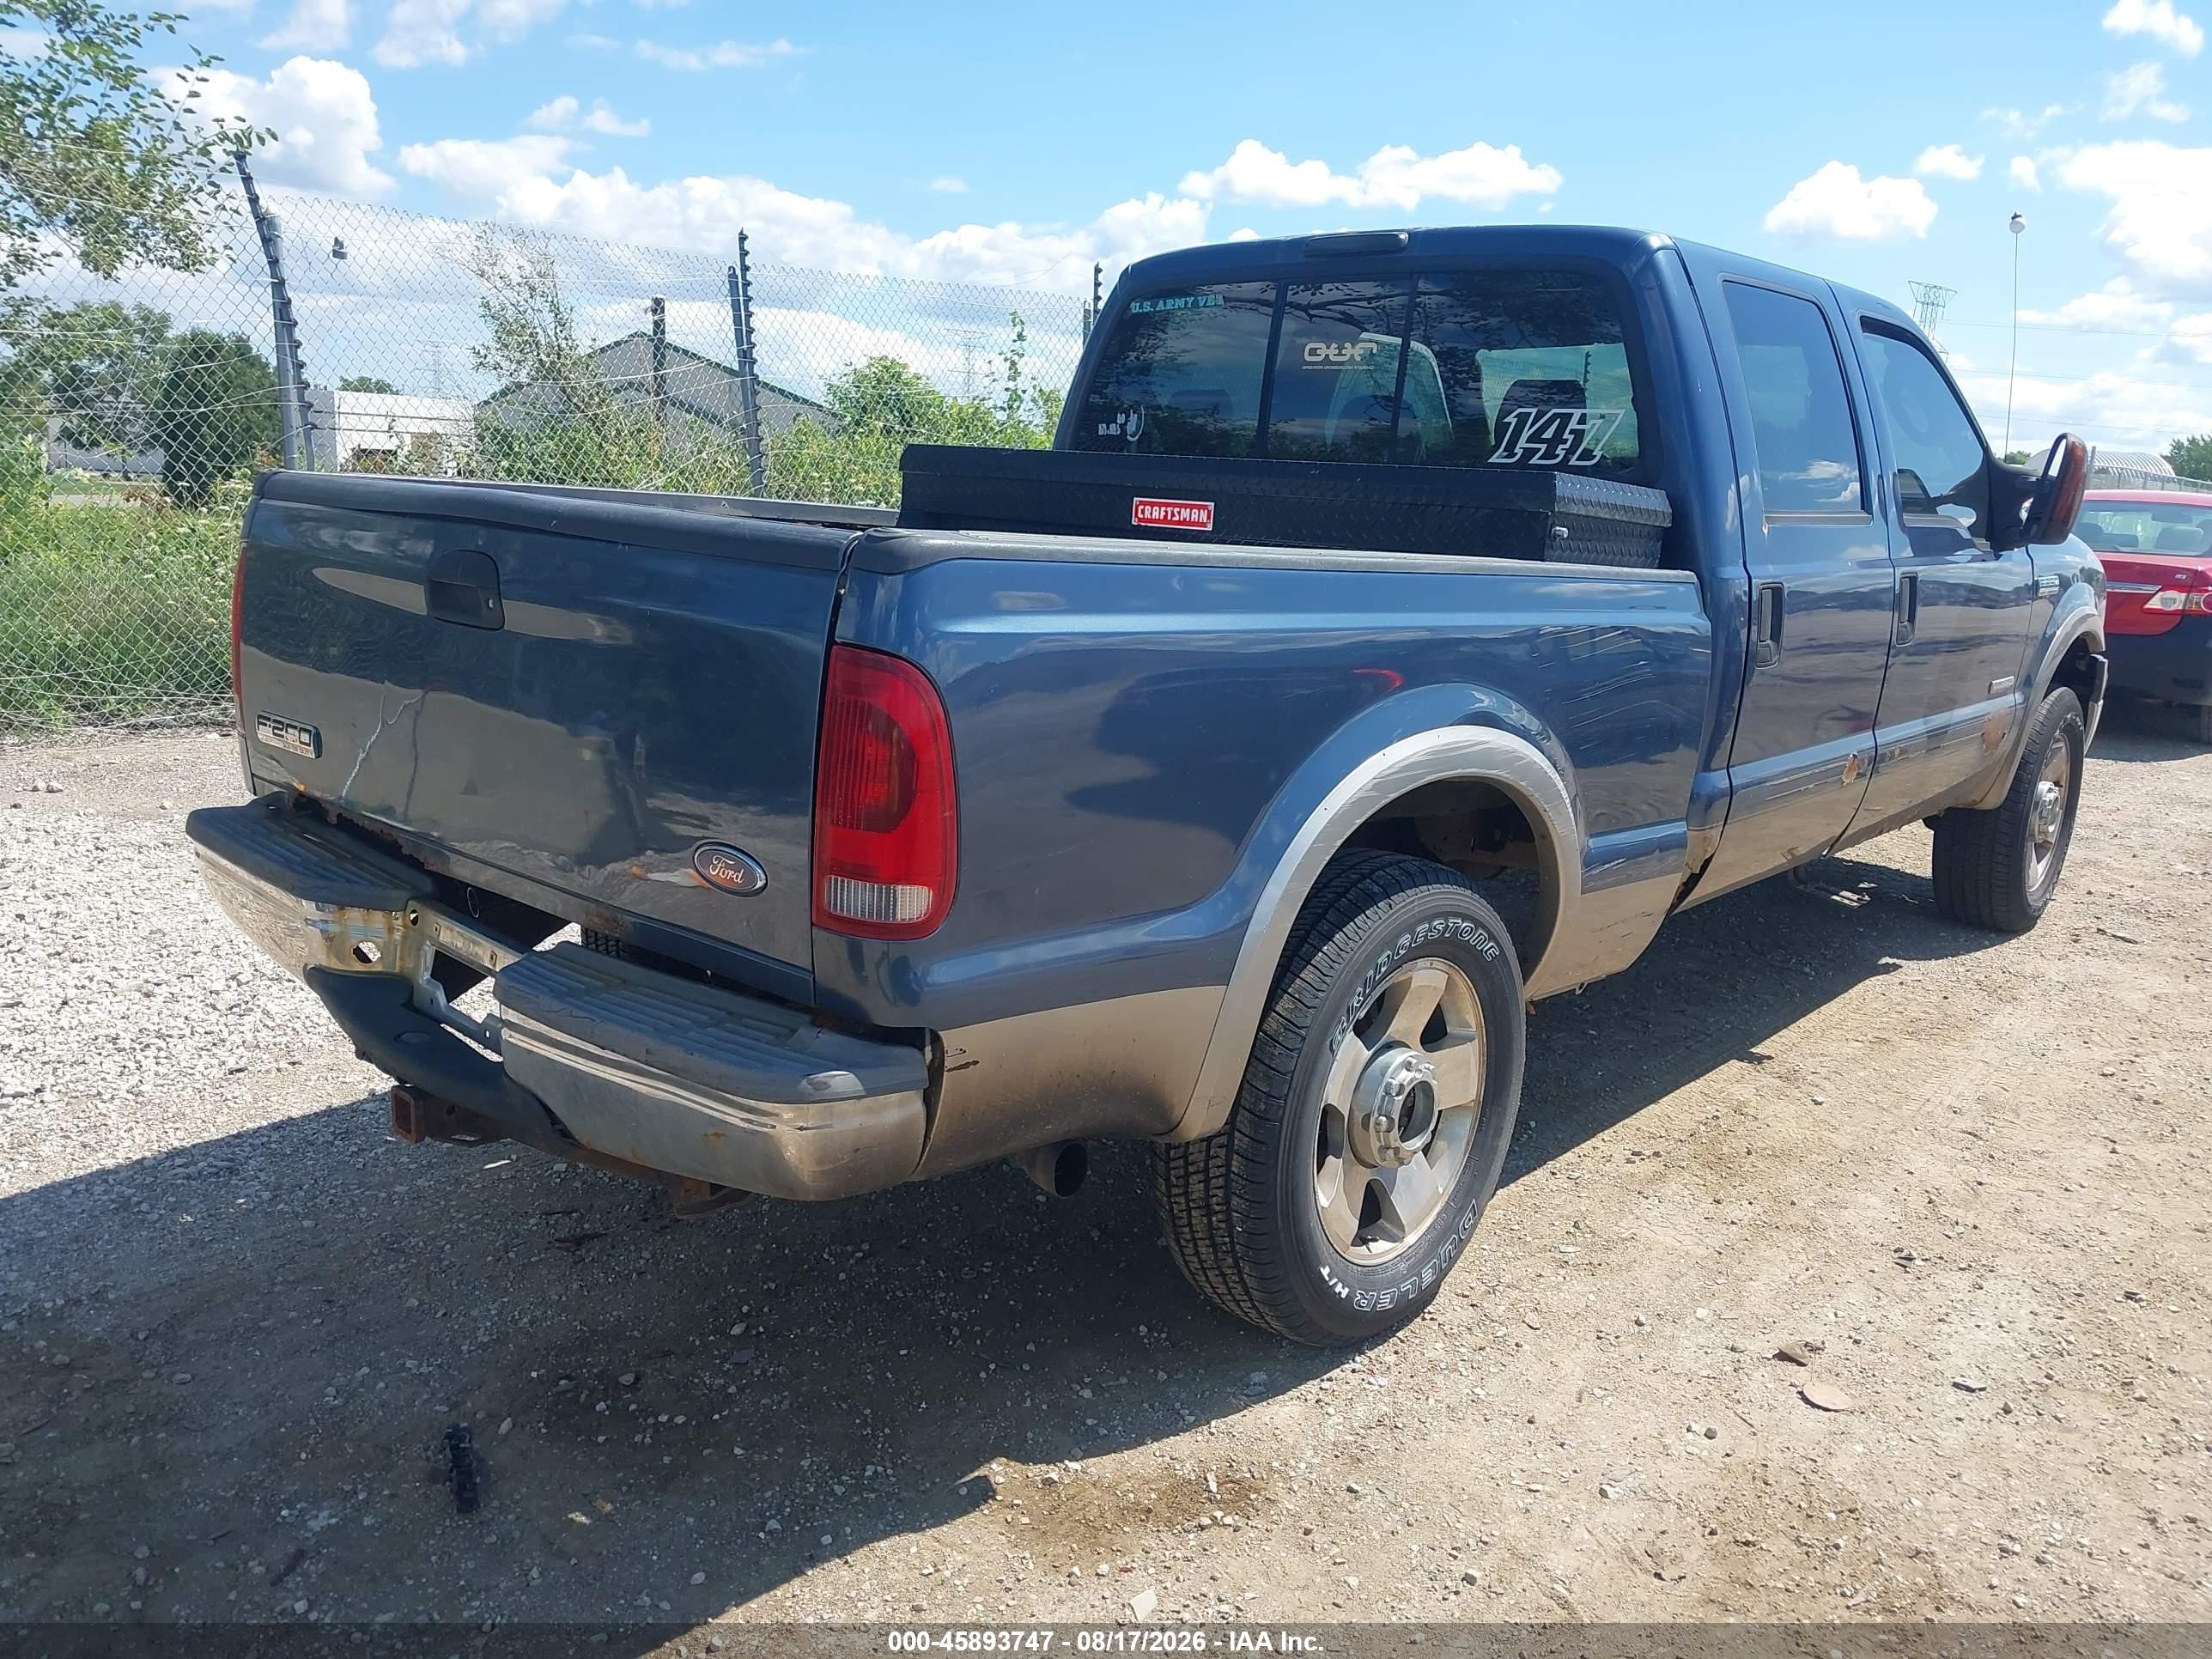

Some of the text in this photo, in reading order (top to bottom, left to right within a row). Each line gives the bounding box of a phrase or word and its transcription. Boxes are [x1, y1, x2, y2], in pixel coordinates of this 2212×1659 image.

[1130, 301, 1153, 313] U.S.
[1156, 296, 1194, 311] ARMY
[1487, 407, 1626, 466] 147
[1137, 505, 1208, 523] CRAFTSMAN
[258, 714, 313, 748] F-250
[709, 854, 745, 884] Ford
[1330, 916, 1500, 1058] BRIDGESTONE
[1320, 1198, 1478, 1311] DUELER H/T
